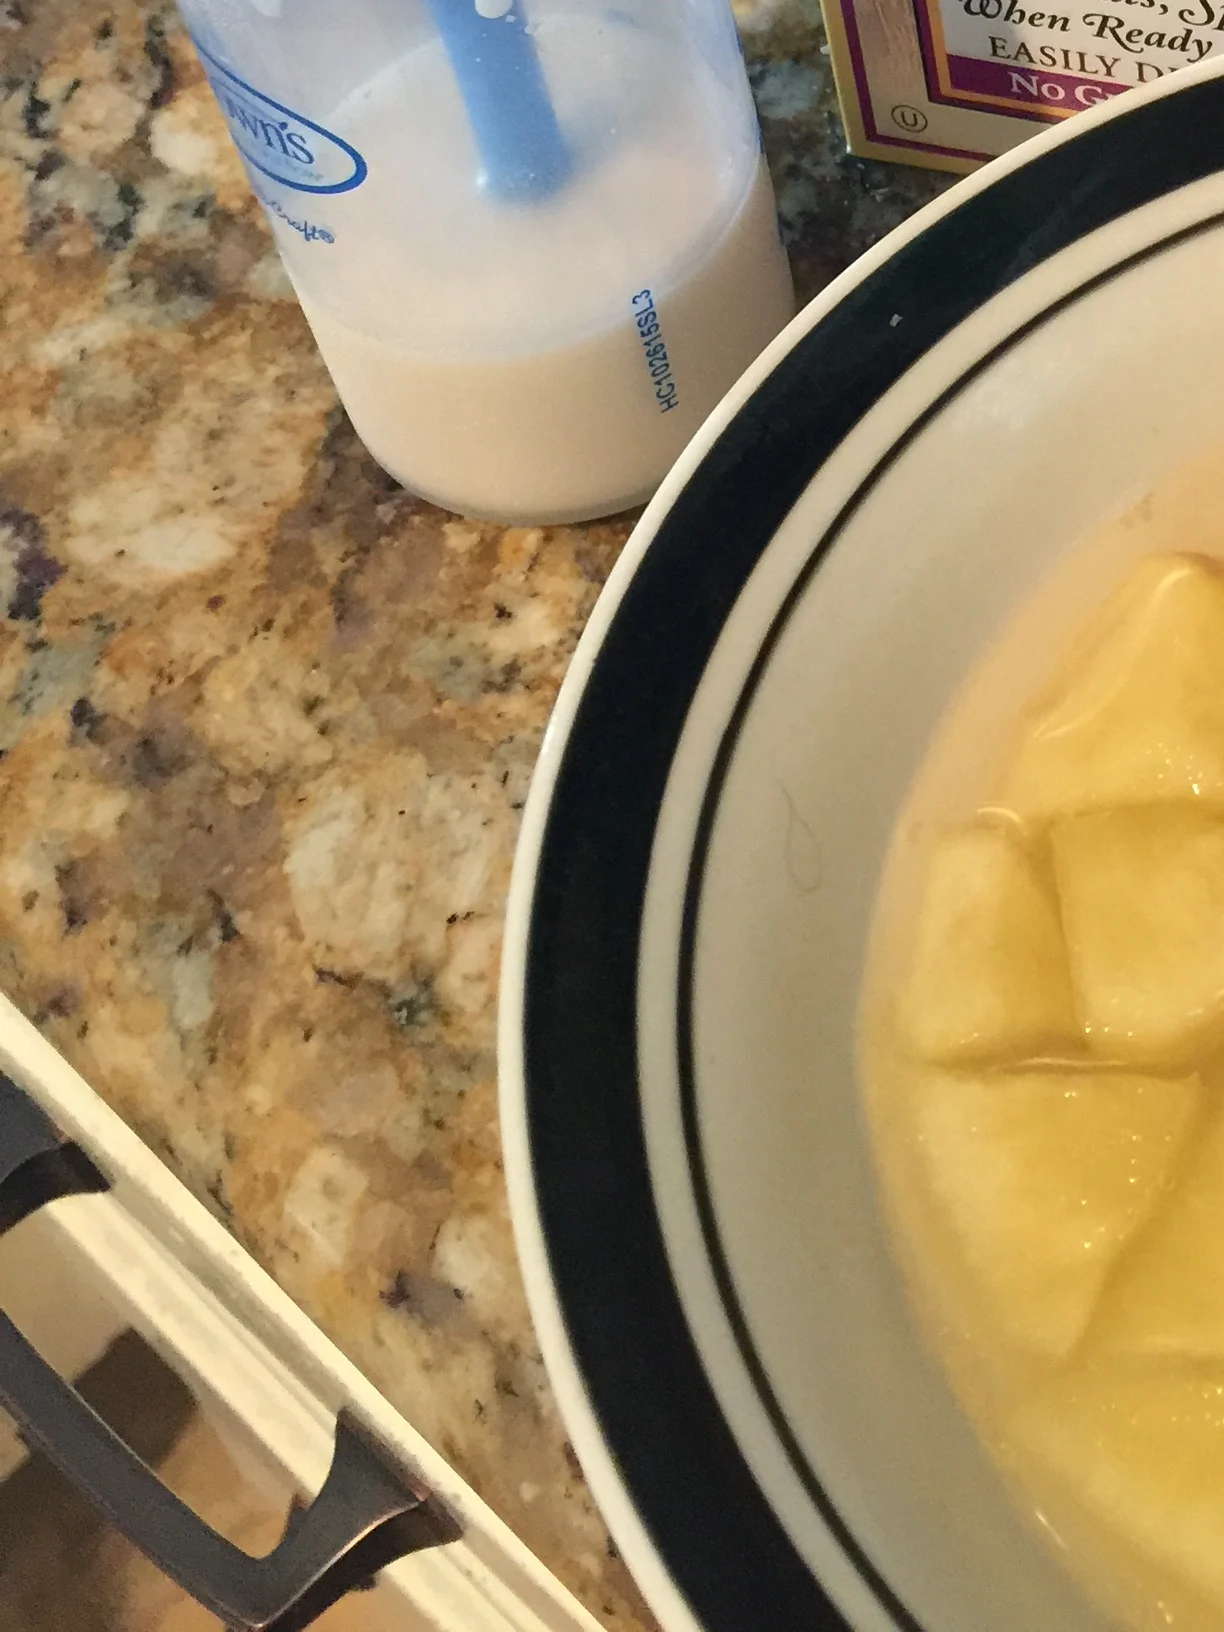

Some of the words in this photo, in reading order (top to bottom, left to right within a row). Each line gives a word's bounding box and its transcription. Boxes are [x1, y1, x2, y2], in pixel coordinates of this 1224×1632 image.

[988, 36, 1121, 78] EASILY
[1082, 12, 1214, 65] Ready
[1010, 72, 1067, 102] No
